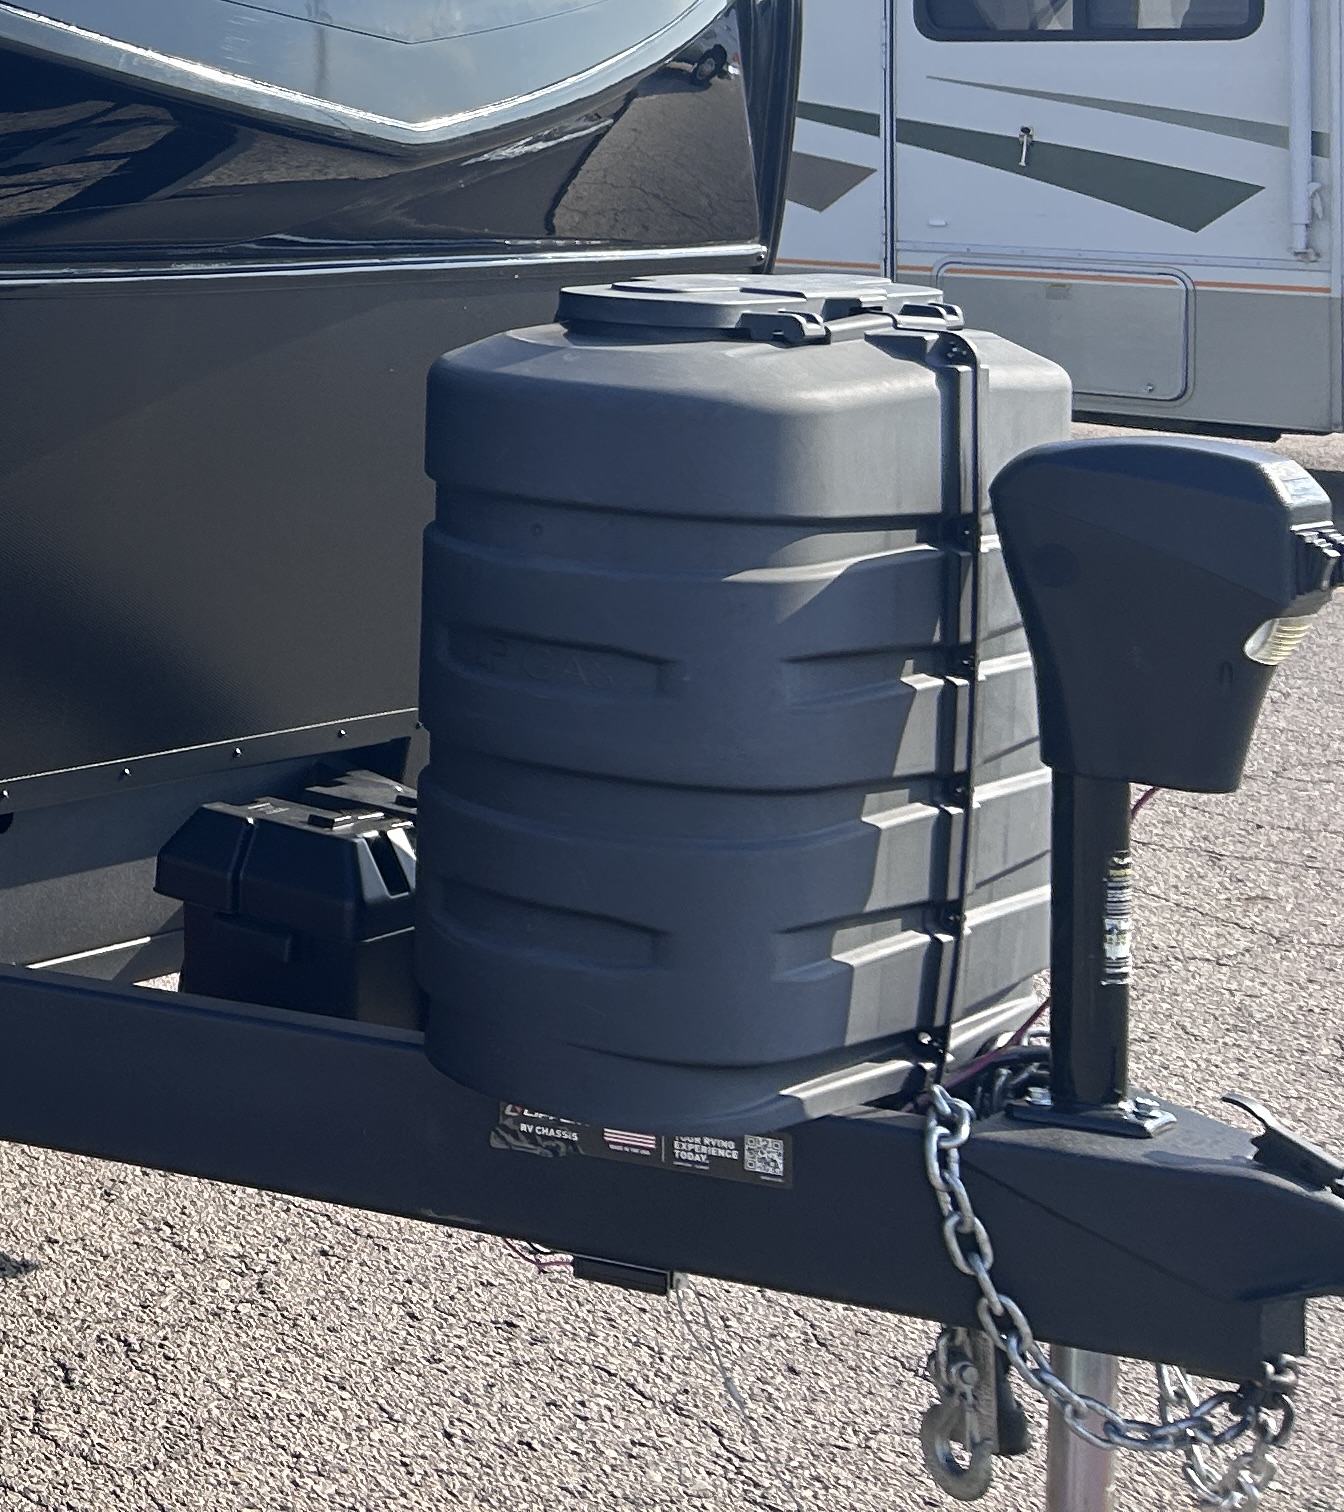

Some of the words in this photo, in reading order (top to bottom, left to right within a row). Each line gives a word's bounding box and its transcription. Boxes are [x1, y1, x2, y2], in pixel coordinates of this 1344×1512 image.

[520, 1123, 534, 1134] RV
[535, 1126, 580, 1142] CHASSIS
[673, 1140, 739, 1160] EXPERIENCE
